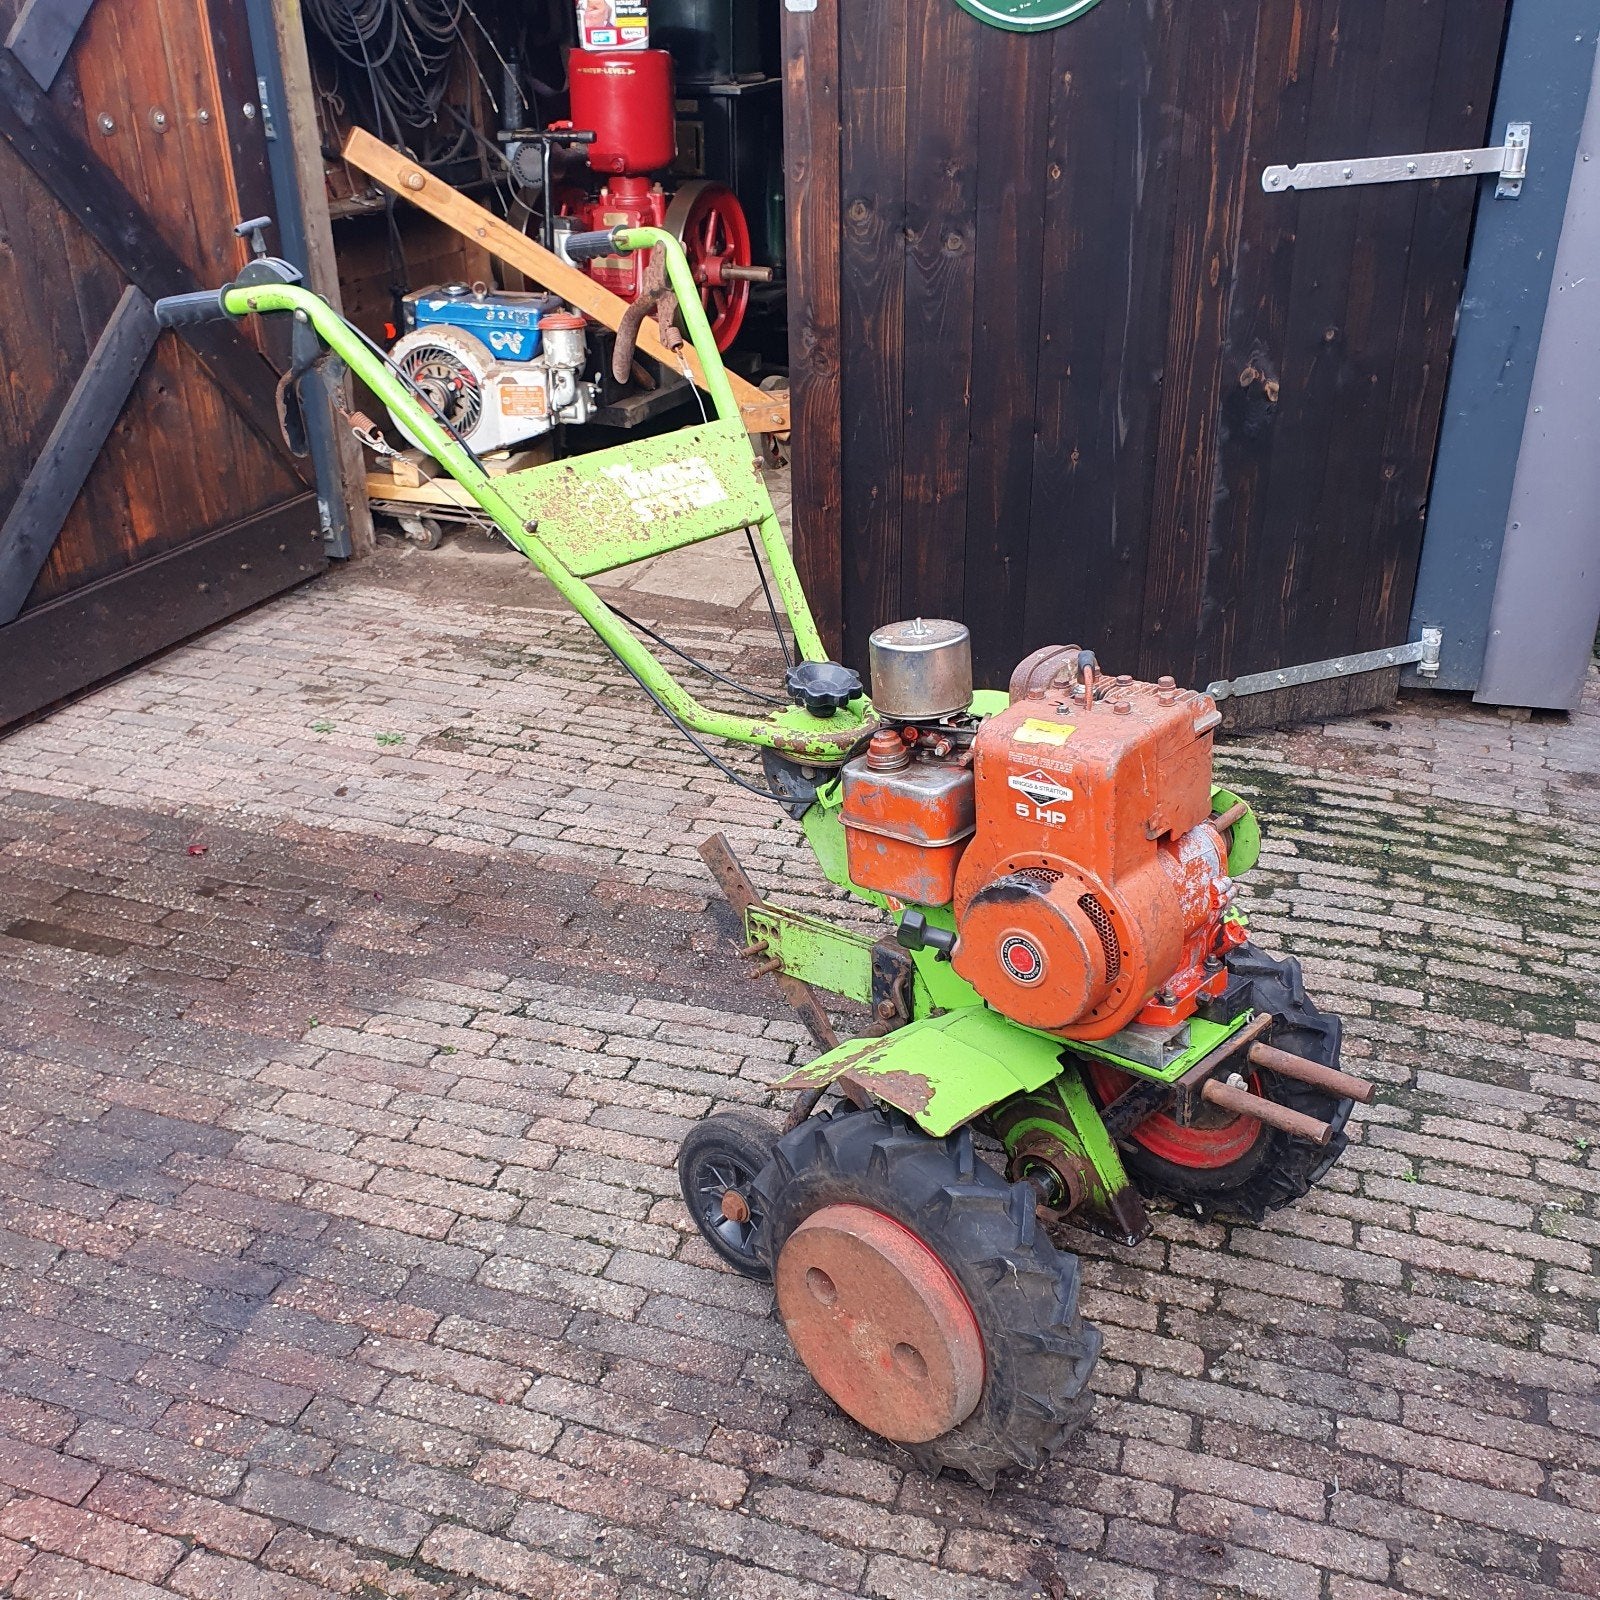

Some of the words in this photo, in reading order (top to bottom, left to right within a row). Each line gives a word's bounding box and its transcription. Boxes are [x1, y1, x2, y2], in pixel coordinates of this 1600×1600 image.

[1012, 779, 1033, 789] BRIGGS
[1039, 785, 1068, 796] STRATTON
[1015, 802, 1030, 817] 5
[1035, 807, 1067, 824] HP
